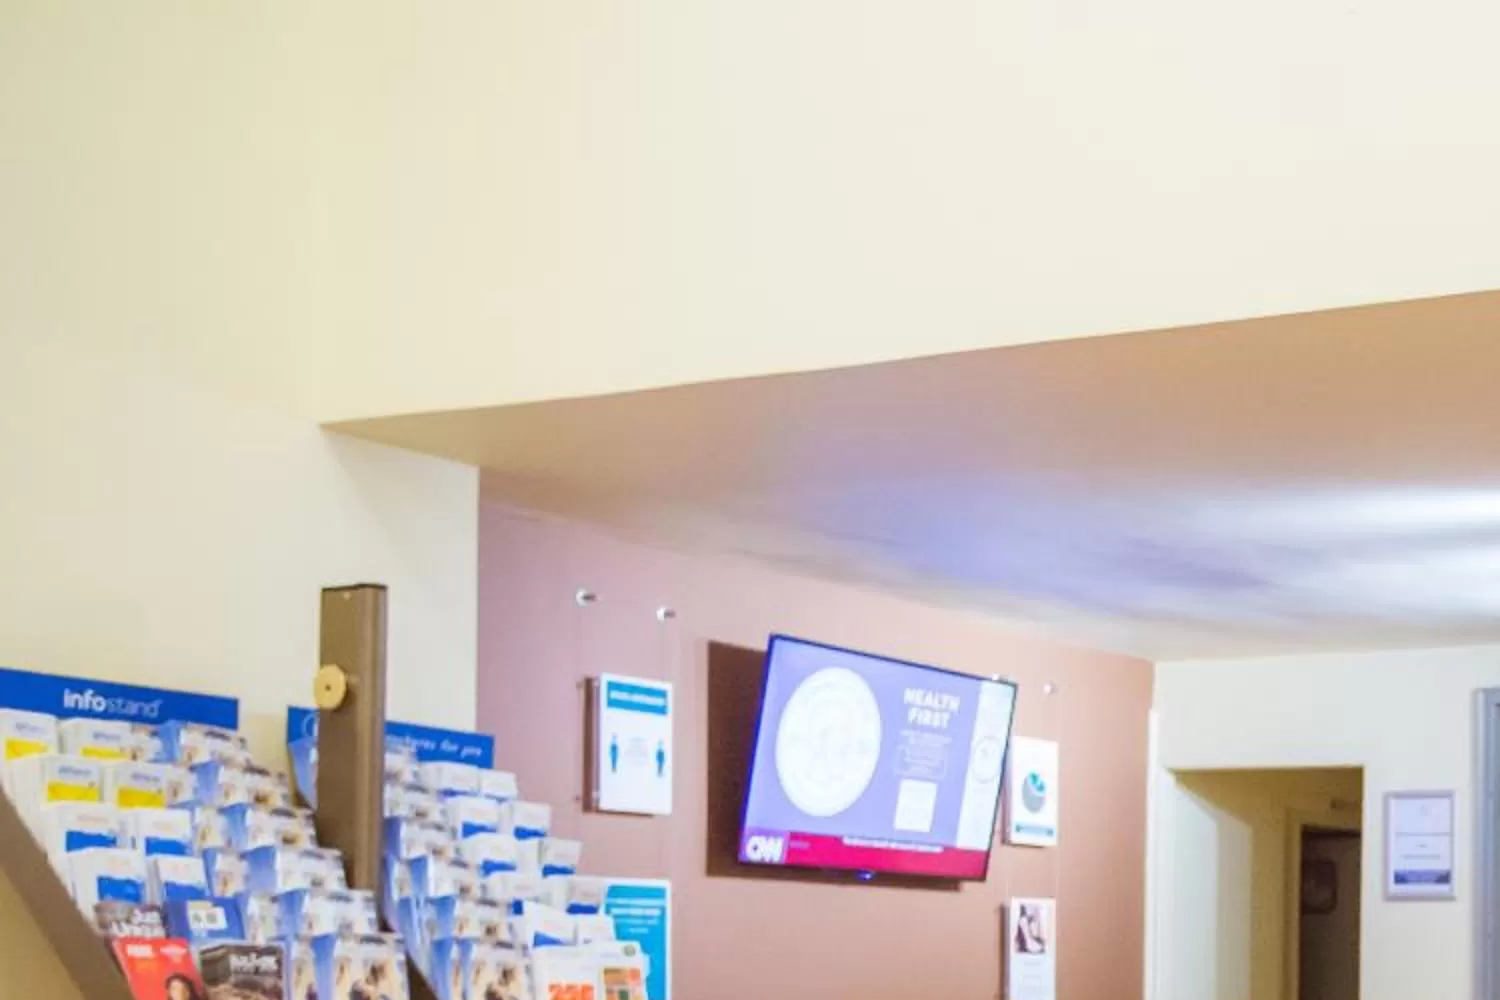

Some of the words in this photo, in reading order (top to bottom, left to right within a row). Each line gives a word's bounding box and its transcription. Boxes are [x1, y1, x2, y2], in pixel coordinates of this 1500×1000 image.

[63, 687, 160, 718] infostand
[903, 687, 961, 715] HEALTH
[907, 707, 951, 730] FIRST
